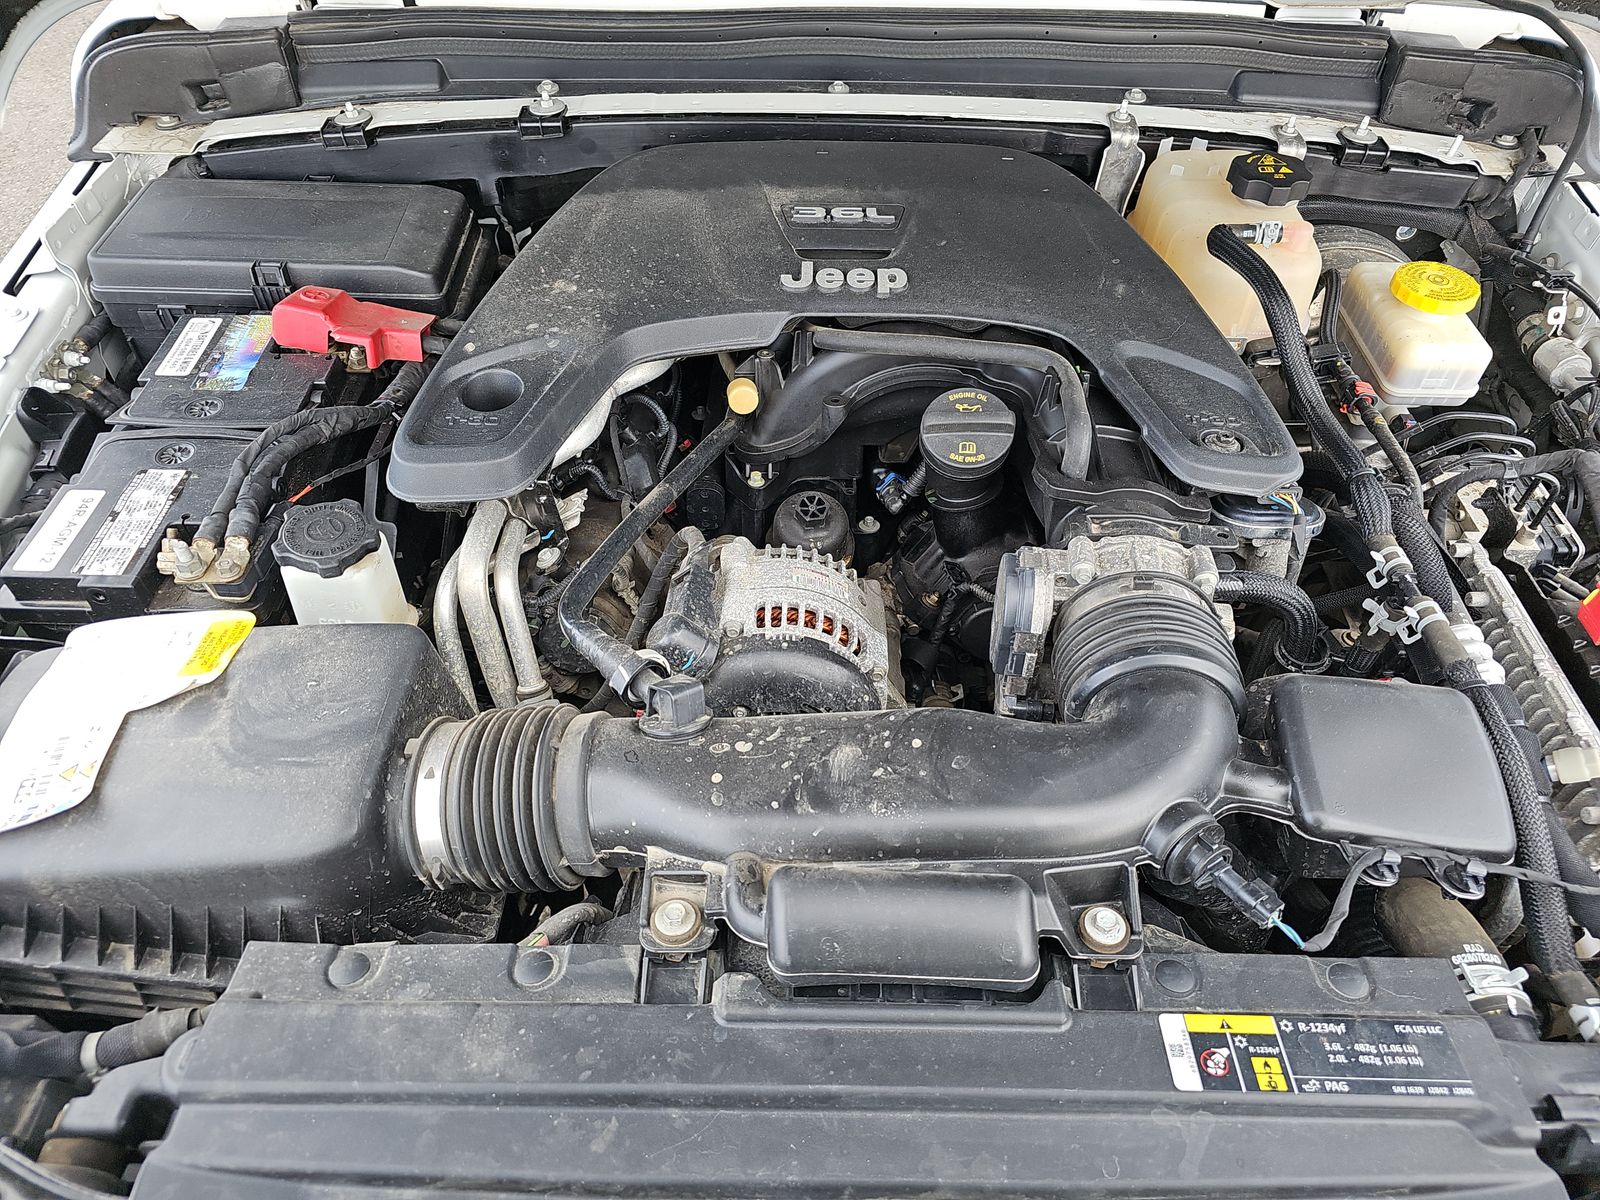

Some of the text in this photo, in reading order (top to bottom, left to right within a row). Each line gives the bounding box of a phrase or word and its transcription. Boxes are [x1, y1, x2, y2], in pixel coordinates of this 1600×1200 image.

[791, 206, 896, 224] 3.6L
[780, 261, 908, 297] Jeep
[948, 392, 988, 402] ENGINE OIL
[949, 452, 965, 462] SAE
[39, 496, 95, 565] 94R-AGM-12
[1462, 944, 1485, 953] RAD
[1297, 1022, 1346, 1036] R-1234yf
[1394, 1024, 1444, 1035] FCA US LLC
[1248, 1045, 1280, 1056] R-1234yf
[1323, 1042, 1345, 1051] 3.6L
[1353, 1043, 1378, 1054] 482g
[1327, 1054, 1349, 1063] 2.0L
[1358, 1055, 1382, 1066] 482g
[1324, 1080, 1349, 1092] PAG
